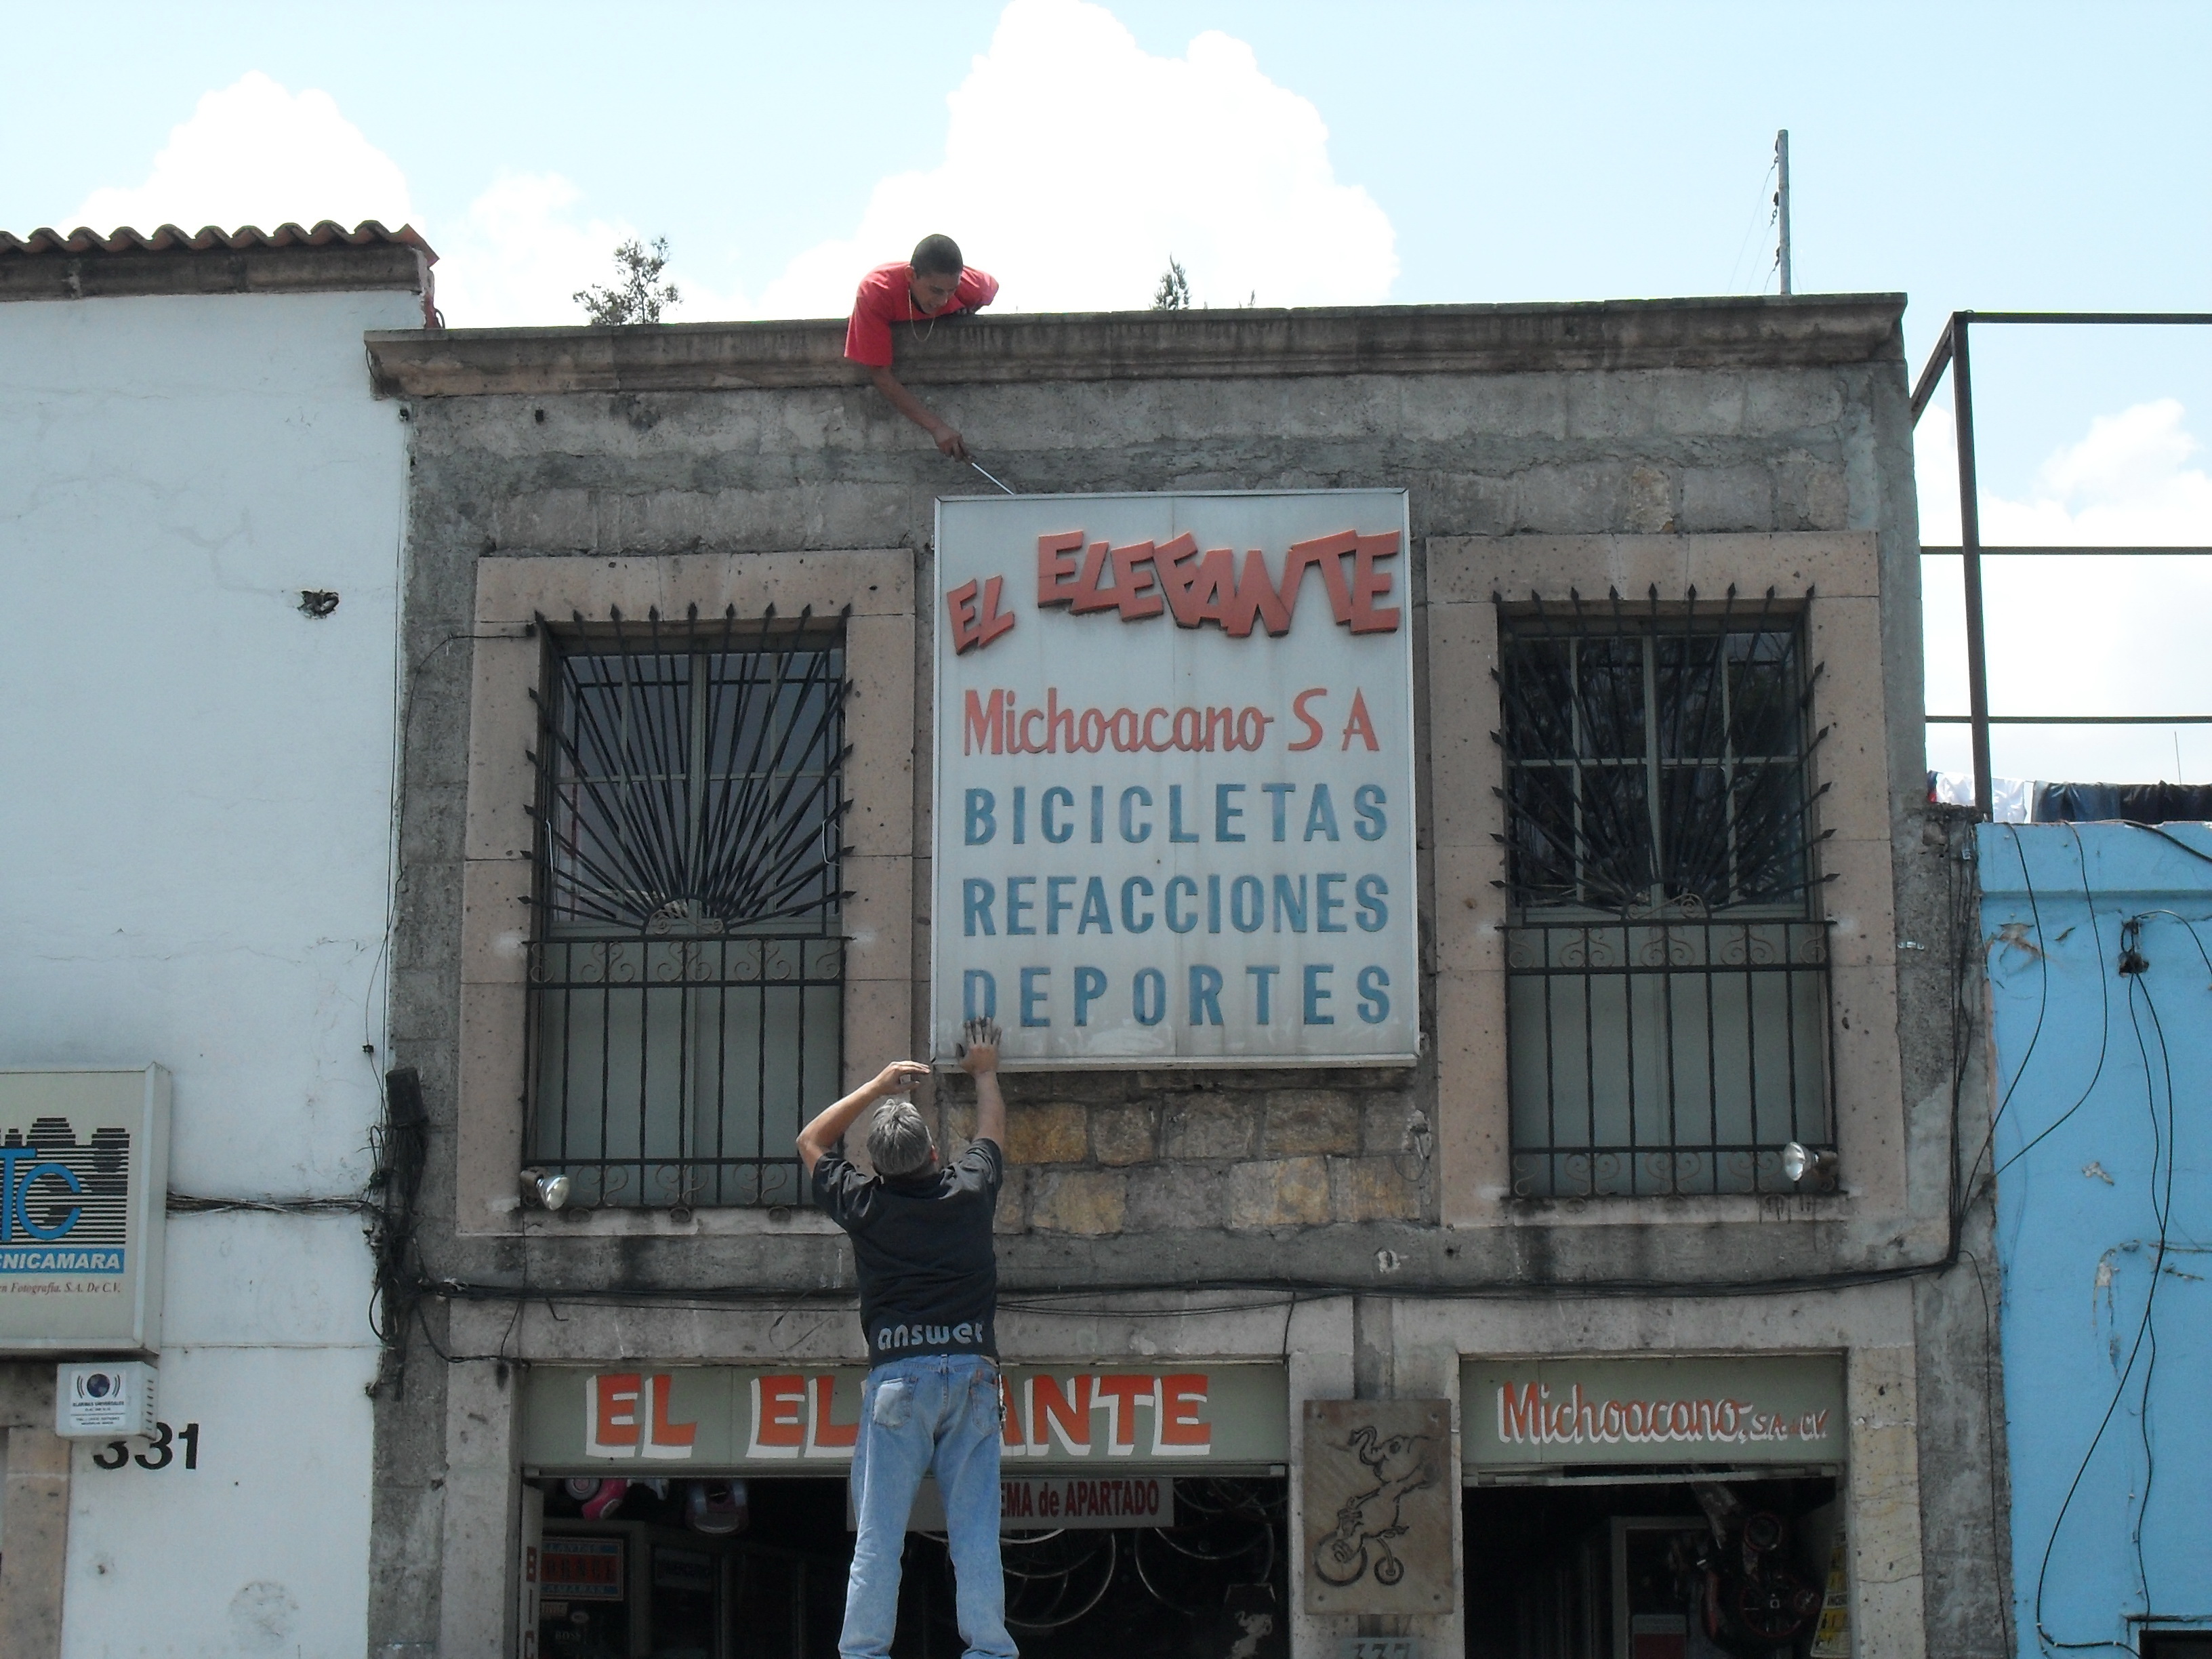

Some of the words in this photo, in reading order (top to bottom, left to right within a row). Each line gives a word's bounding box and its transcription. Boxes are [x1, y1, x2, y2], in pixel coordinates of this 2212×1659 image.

[947, 575, 1015, 656] EL
[1038, 529, 1401, 637] ELEFANTE
[964, 687, 1274, 756] Michoacano
[1287, 687, 1328, 752] S
[1342, 687, 1380, 752] A
[964, 783, 1387, 846] BICICLETAS
[963, 872, 1389, 937] REFACCIONES
[963, 964, 1390, 1027] DEPORTES
[0, 1252, 121, 1269] NICAMARA
[877, 1321, 984, 1351] answer
[93, 1422, 199, 1470] 331
[586, 1372, 697, 1459] EL
[1038, 1482, 1060, 1517] de
[1064, 1480, 1160, 1517] APARTADO
